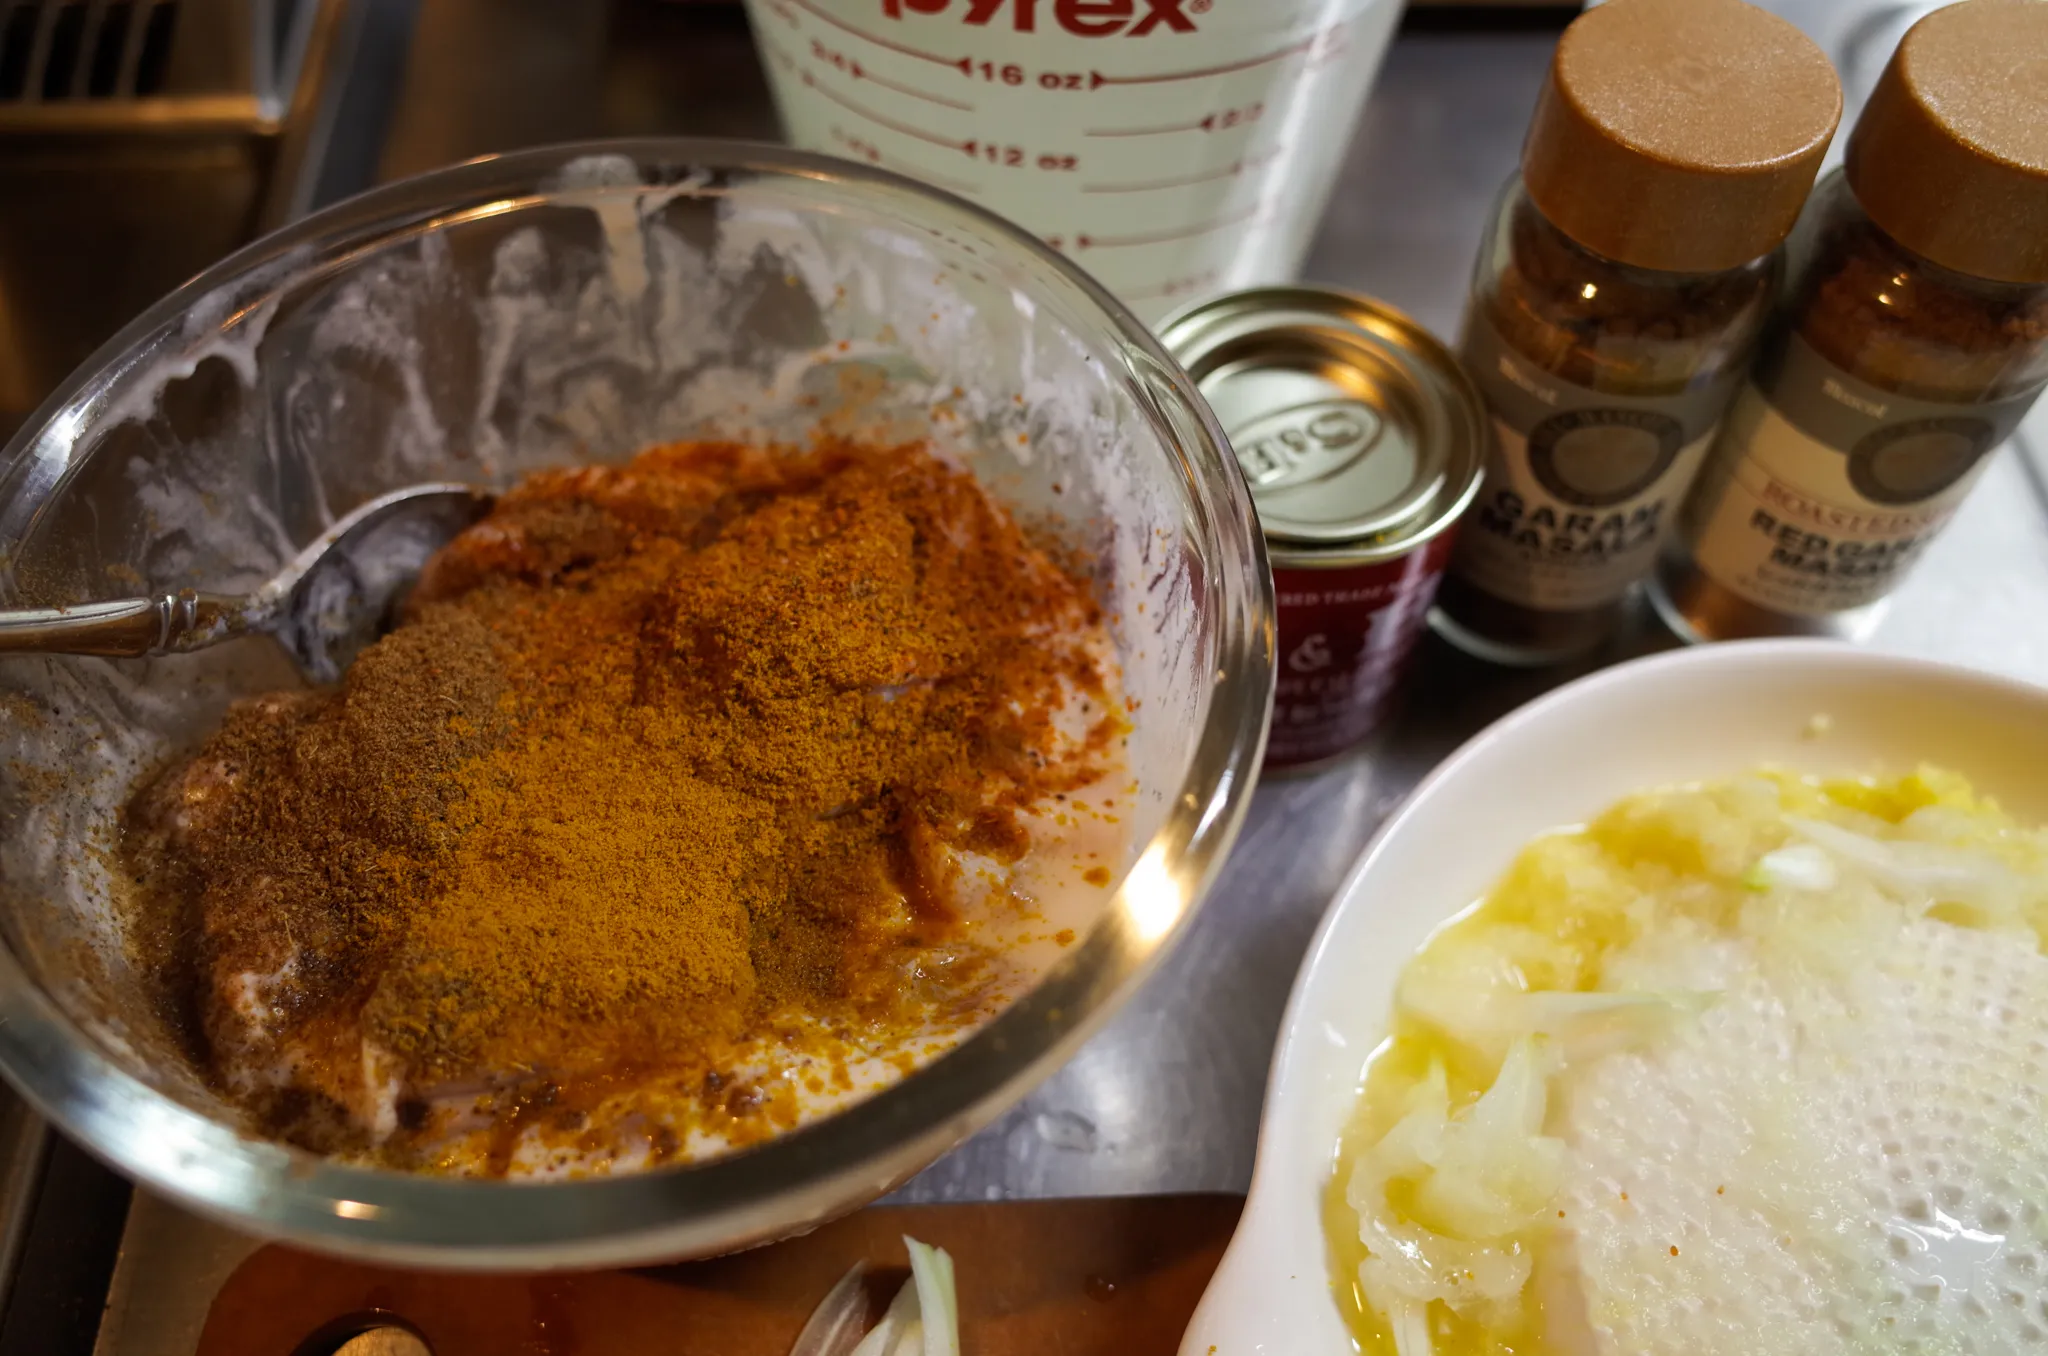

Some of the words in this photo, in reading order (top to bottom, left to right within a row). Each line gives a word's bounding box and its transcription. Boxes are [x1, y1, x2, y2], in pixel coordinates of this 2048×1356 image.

[978, 61, 1024, 87] 16
[1037, 71, 1083, 91] oz
[985, 144, 1025, 168] 12
[1036, 154, 1078, 171] oz
[1478, 503, 1658, 553] MASALA
[1495, 488, 1666, 533] GARAM
[1750, 507, 1829, 554] RED
[1277, 591, 1320, 607] RED
[1288, 632, 1333, 673] &
